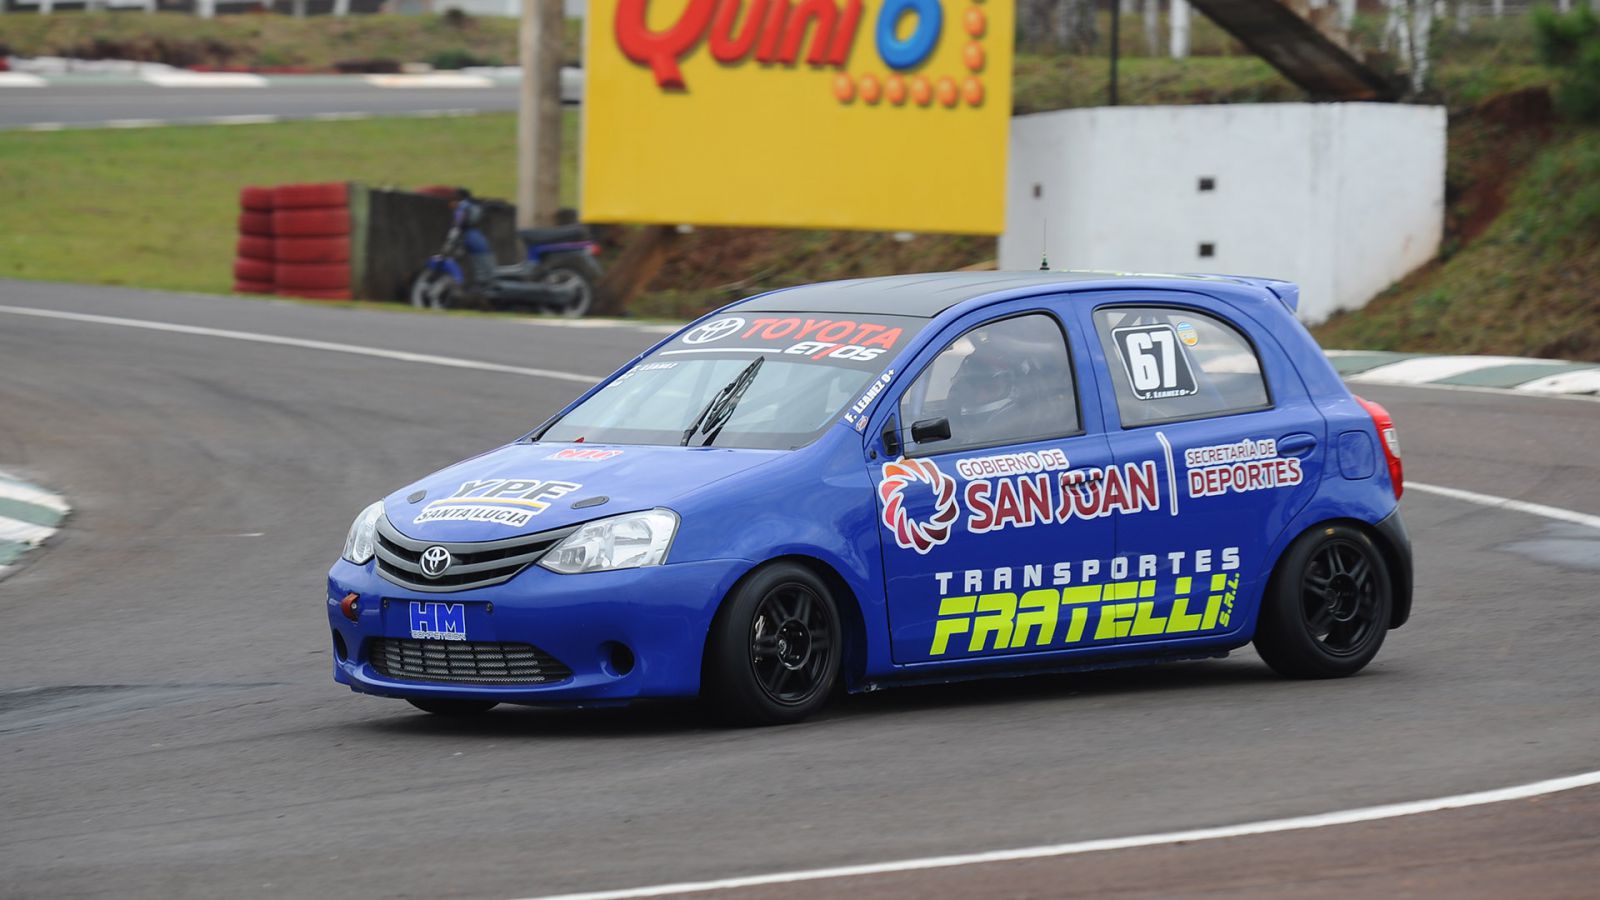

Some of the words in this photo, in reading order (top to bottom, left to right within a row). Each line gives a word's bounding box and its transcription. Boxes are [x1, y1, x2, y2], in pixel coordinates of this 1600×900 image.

[741, 317, 903, 350] TOYOTA
[1126, 330, 1177, 390] 67
[844, 412, 857, 423] F.
[852, 380, 885, 414] LEANEZ
[957, 453, 1040, 479] GOBIERNO
[1040, 449, 1070, 470] DE
[1186, 440, 1256, 465] SECRETARÍA
[1257, 440, 1277, 457] DE
[452, 480, 579, 502] YPF
[966, 475, 1054, 533] SAN
[1056, 461, 1158, 523] JUAN
[1189, 459, 1303, 498] DEPORTES
[417, 508, 469, 522] SANTA
[473, 508, 531, 525] LUCIA
[935, 547, 1240, 595] TRANSPORTES
[410, 601, 466, 634] HM
[929, 573, 1227, 656] FRATELLI
[1219, 573, 1240, 627] S.R.L.
